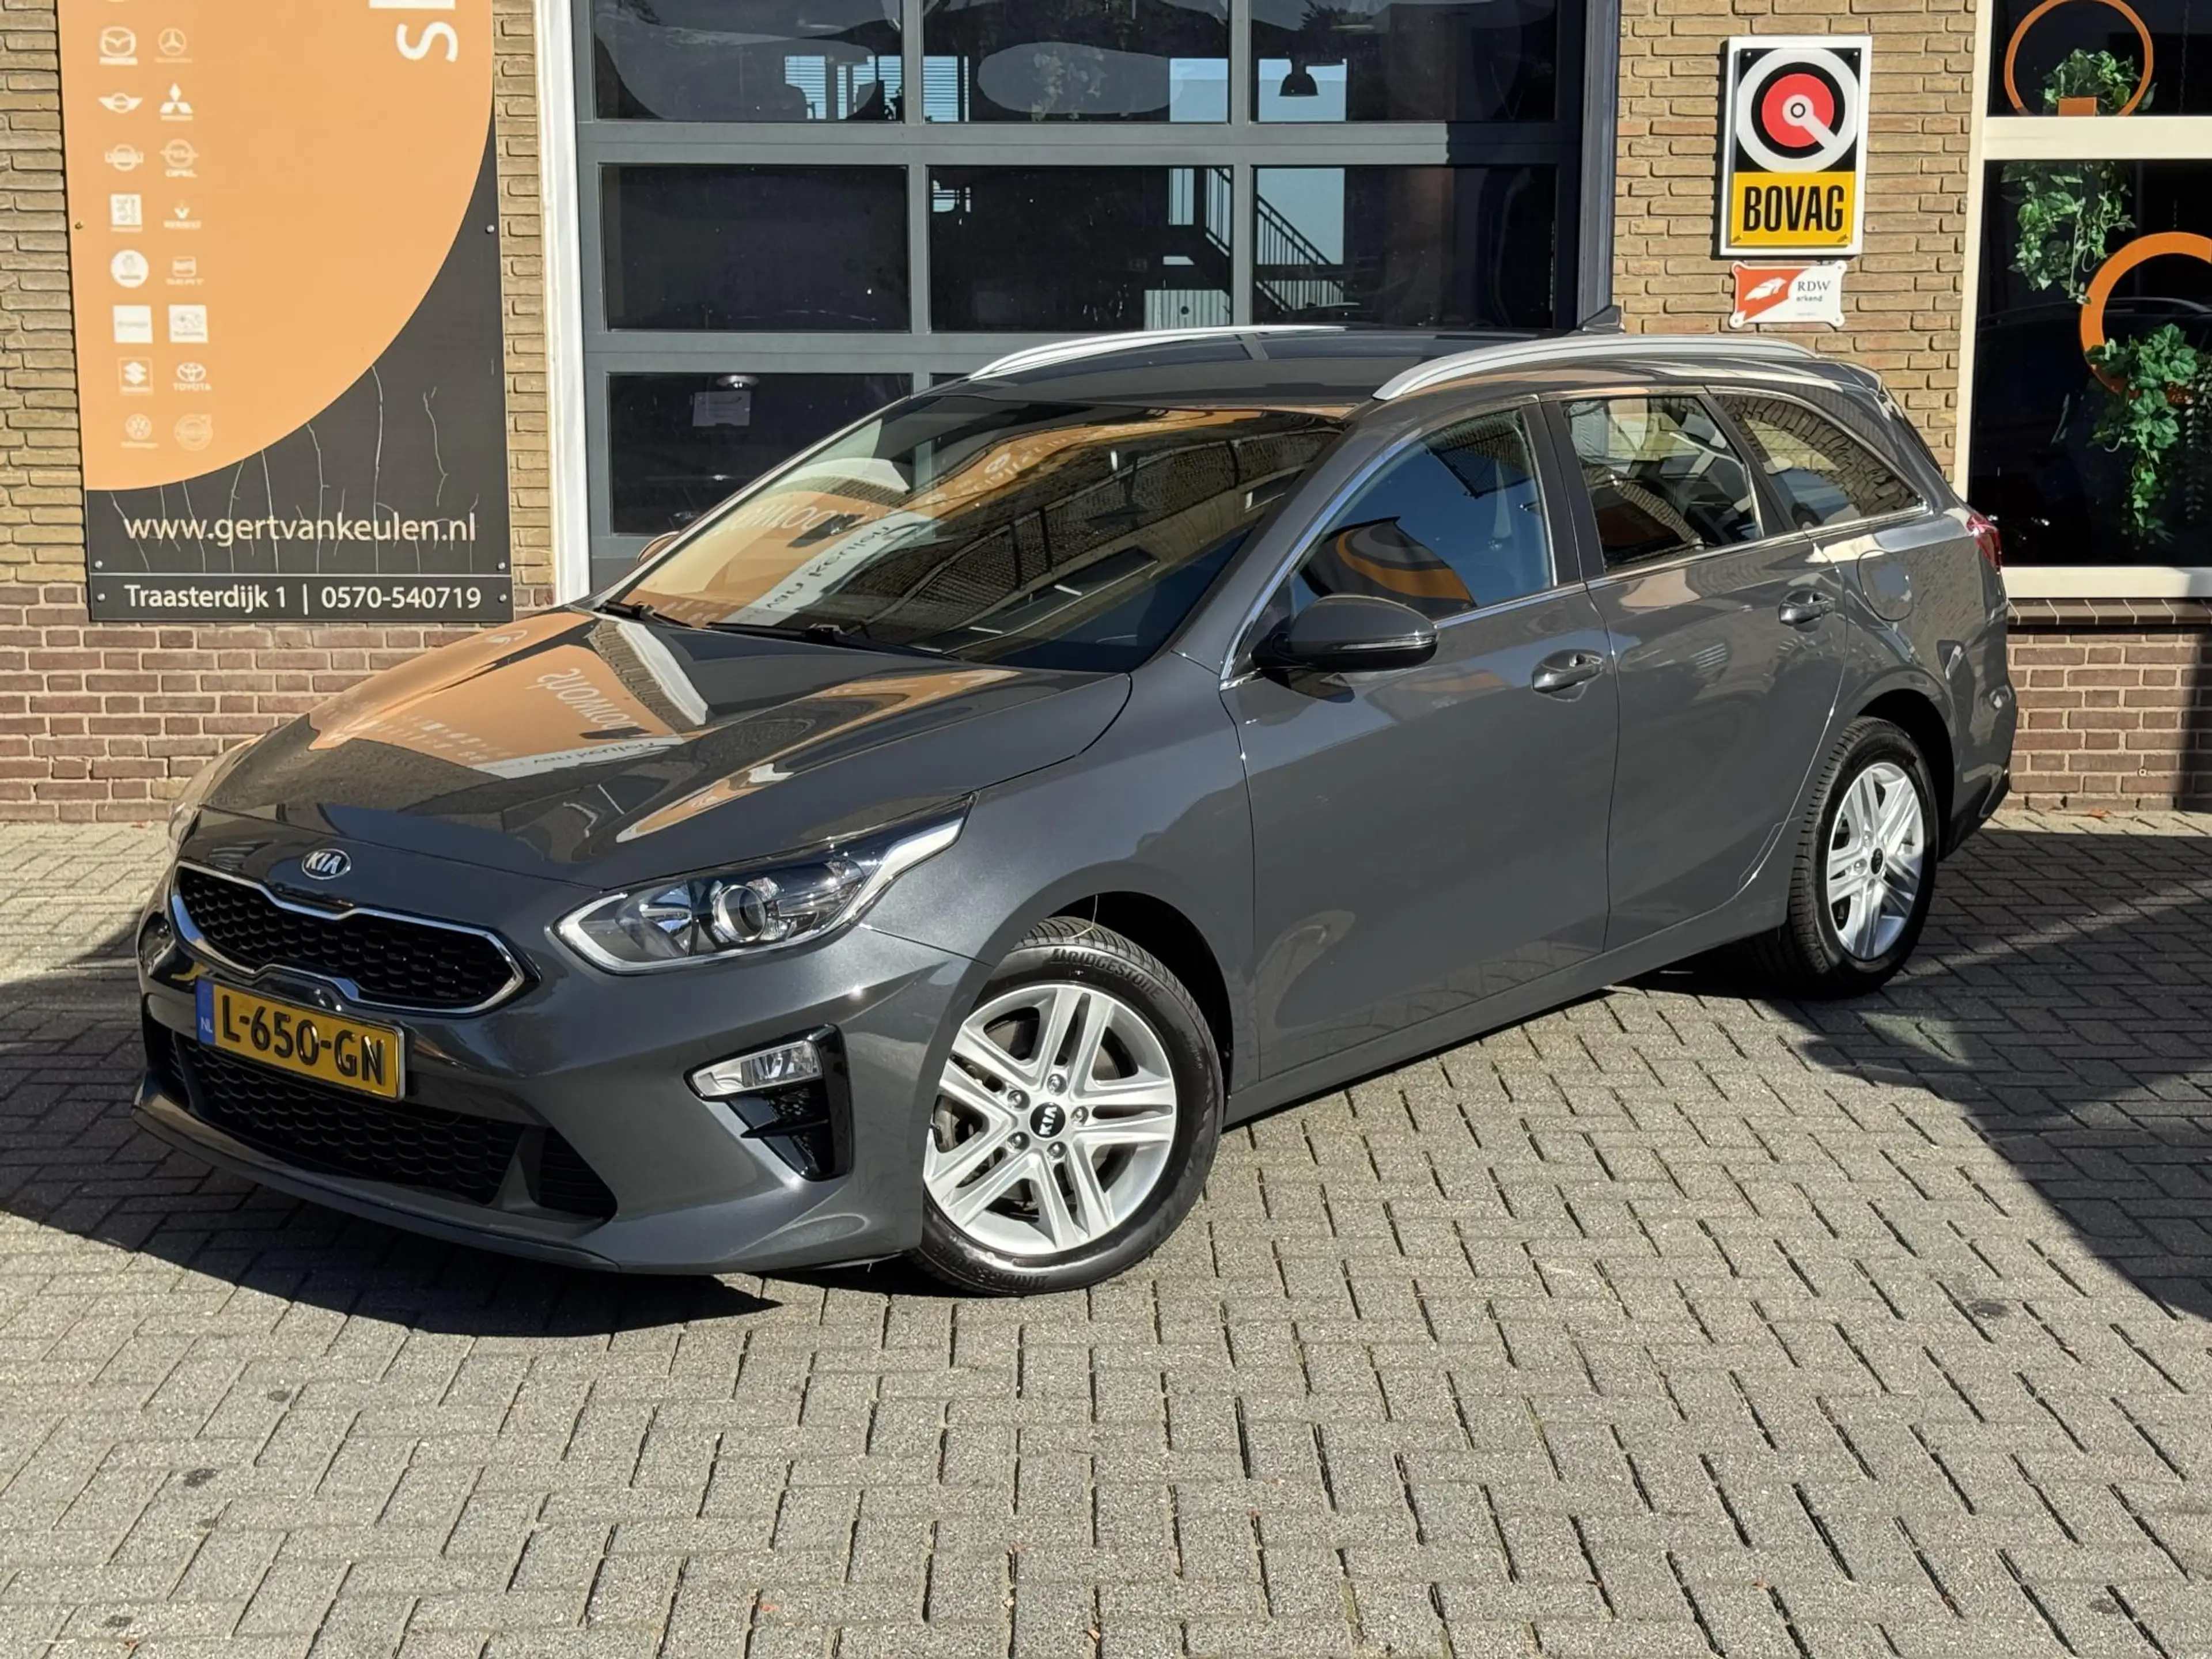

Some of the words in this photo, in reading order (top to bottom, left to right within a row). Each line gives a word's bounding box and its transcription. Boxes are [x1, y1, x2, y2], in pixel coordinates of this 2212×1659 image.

[1743, 185, 1844, 232] BOVAG
[1797, 280, 1831, 292] RDW
[123, 511, 476, 547] www.gertvankeulen.nl
[123, 584, 270, 613] Traasterdijk
[276, 586, 287, 608] 1
[321, 585, 482, 609] 0570-540719
[305, 851, 342, 875] KIA
[1050, 948, 1164, 1001] BRIDGESTONE
[200, 1016, 213, 1034] NL
[222, 994, 387, 1086] L-650-GN
[1039, 1107, 1058, 1135] KIA
